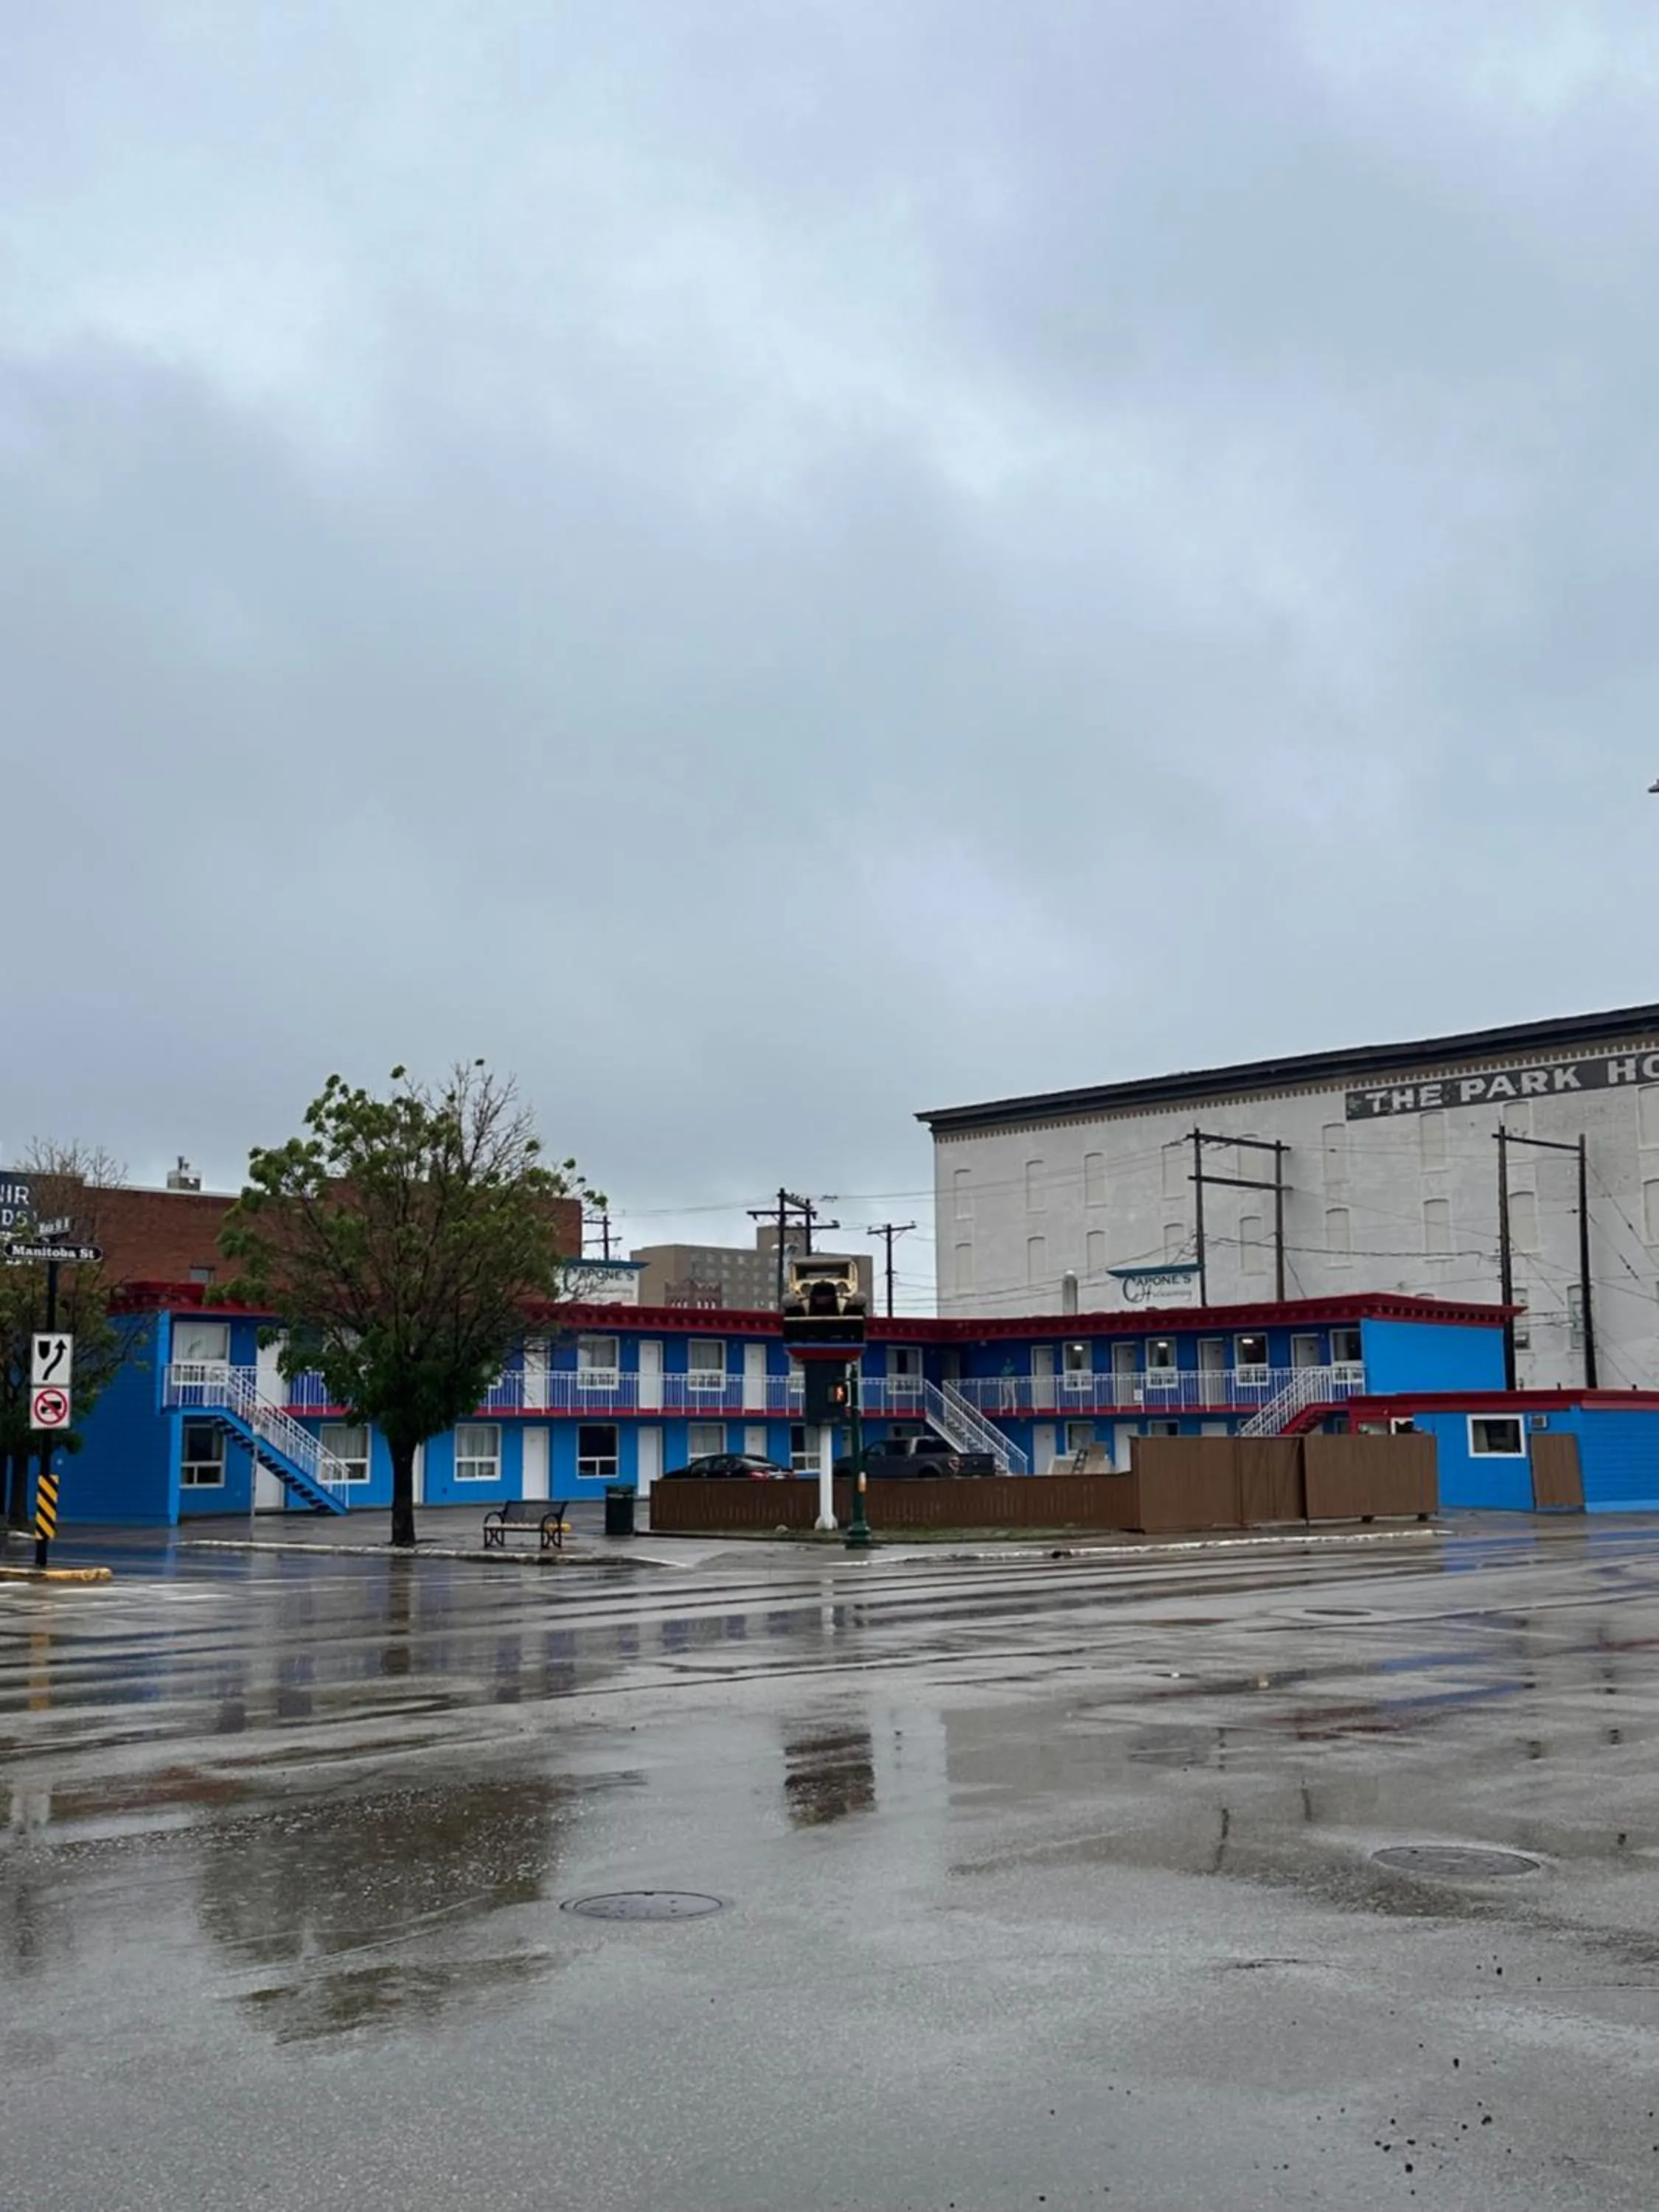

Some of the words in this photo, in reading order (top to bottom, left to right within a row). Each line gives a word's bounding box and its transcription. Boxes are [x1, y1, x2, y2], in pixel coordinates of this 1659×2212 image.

[1366, 1083, 1443, 1113] THE
[1459, 1065, 1582, 1102] PARK
[11, 1245, 77, 1258] Manitoba
[79, 1248, 95, 1259] St
